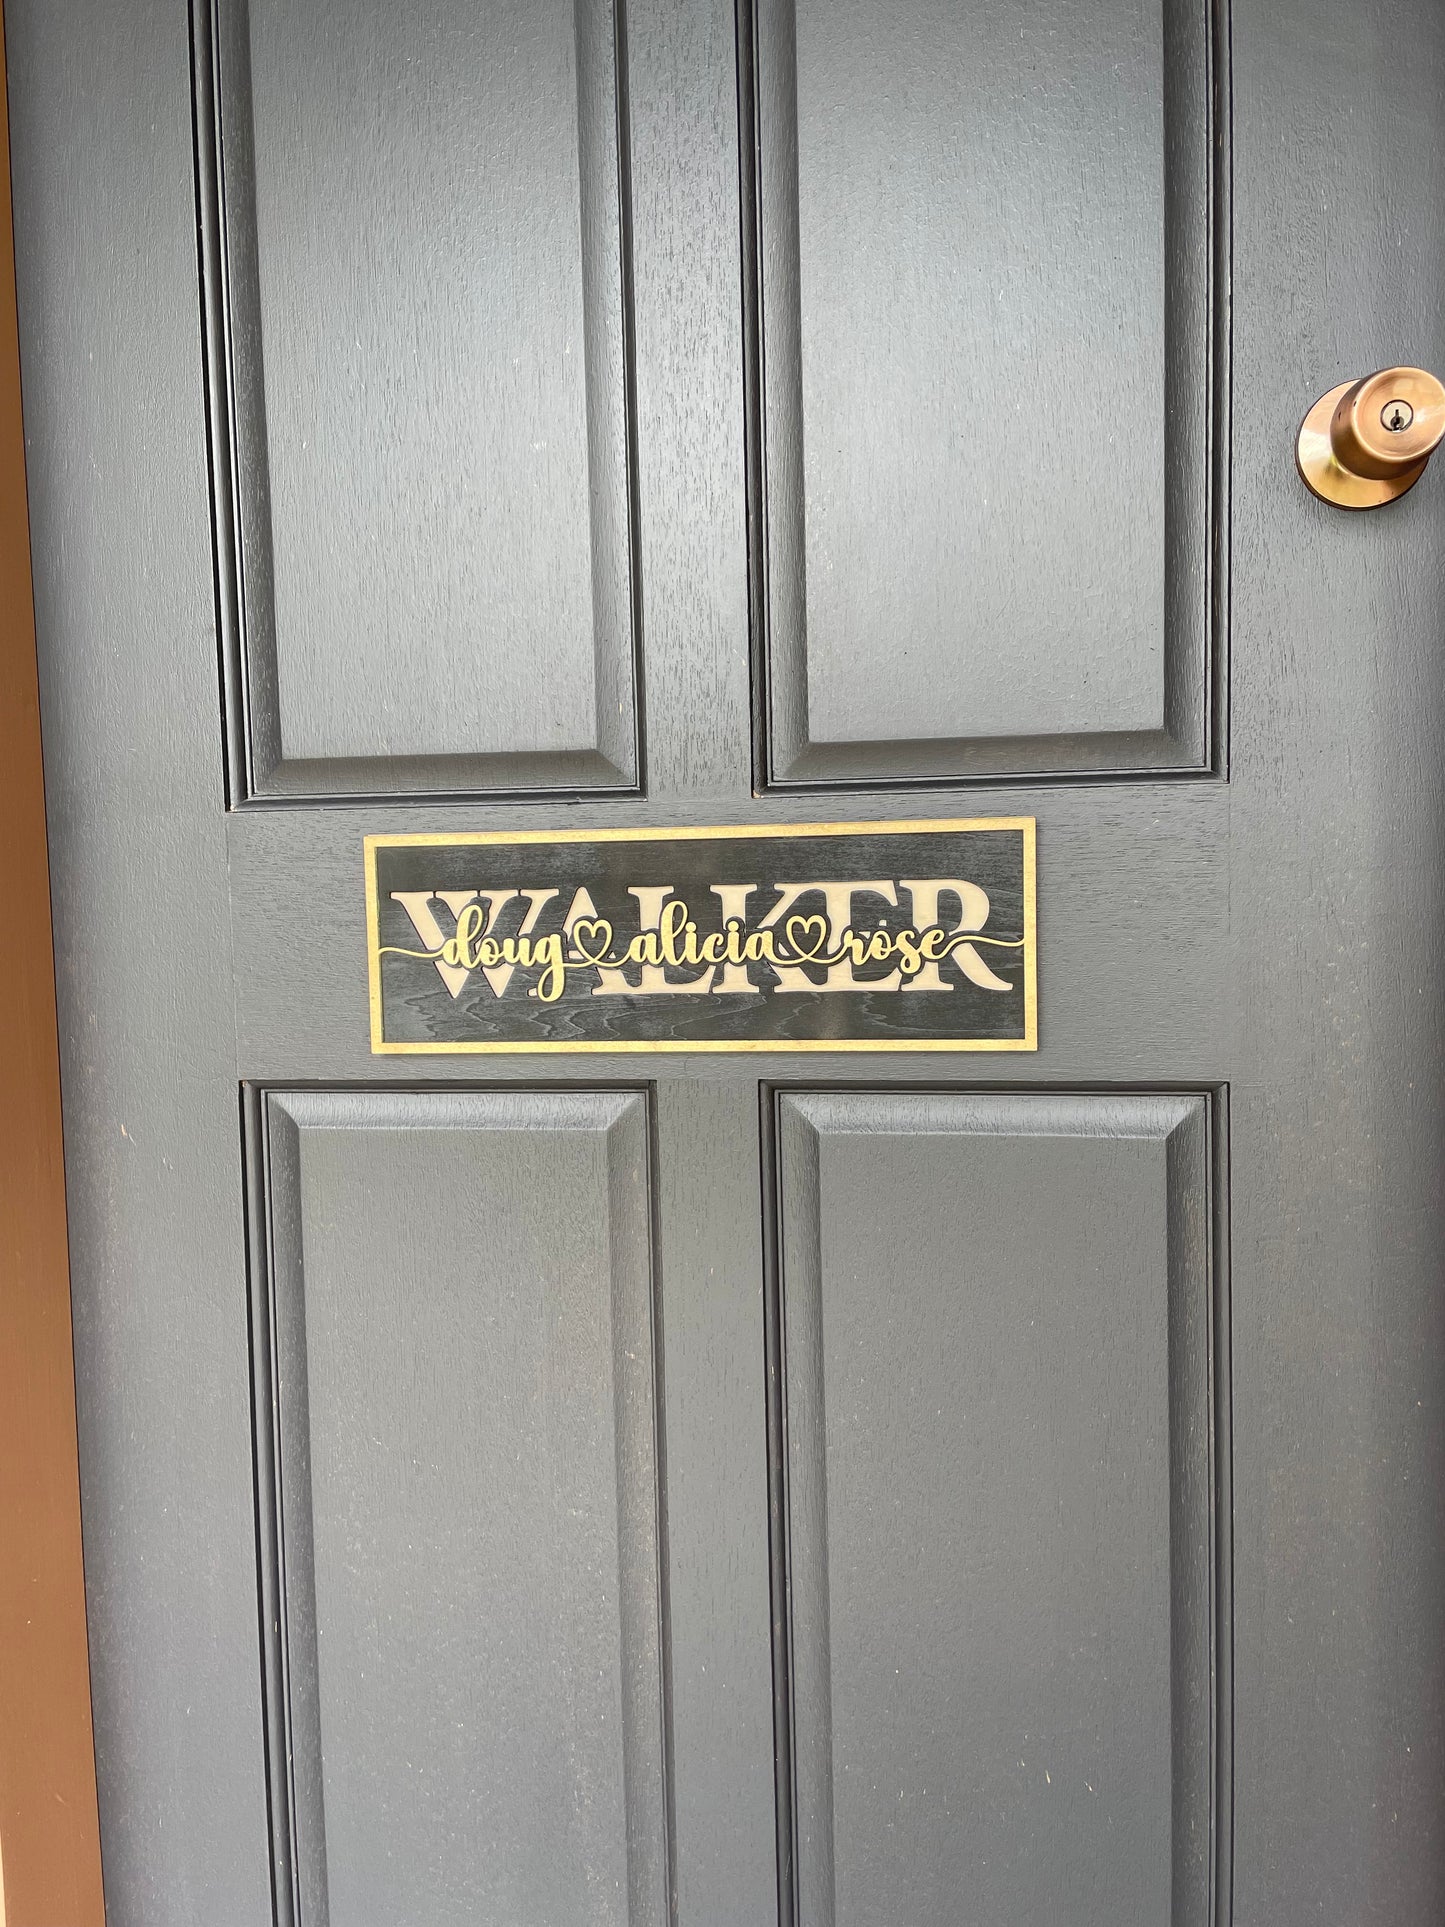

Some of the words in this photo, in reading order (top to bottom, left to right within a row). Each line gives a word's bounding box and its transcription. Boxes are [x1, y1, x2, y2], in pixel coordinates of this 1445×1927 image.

[390, 879, 1014, 999] WALKER
[442, 904, 565, 1002] doug
[628, 901, 777, 968] alicia
[843, 928, 949, 974] rose
